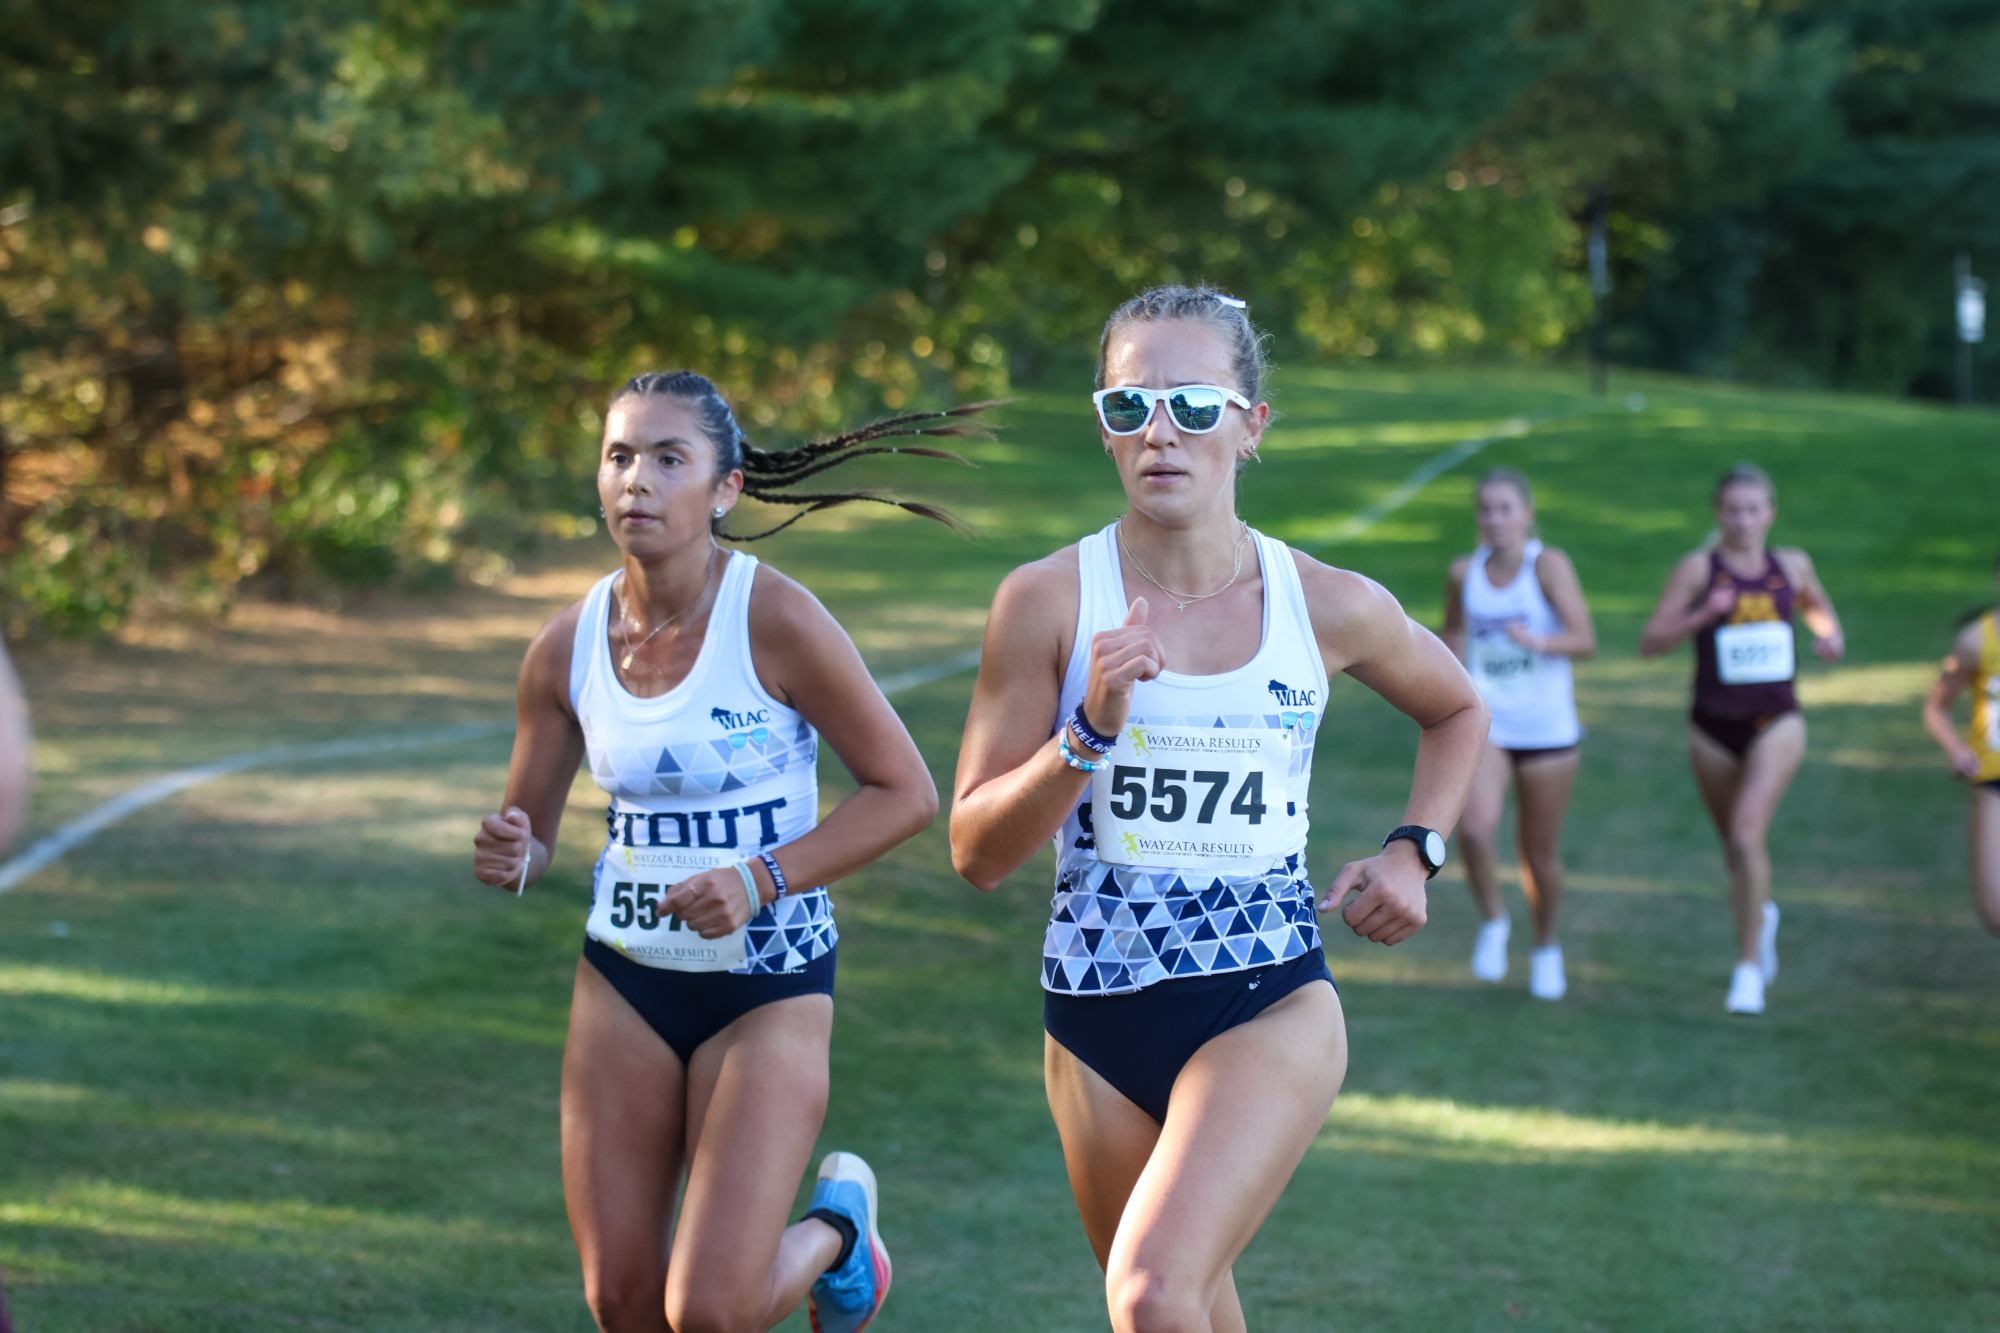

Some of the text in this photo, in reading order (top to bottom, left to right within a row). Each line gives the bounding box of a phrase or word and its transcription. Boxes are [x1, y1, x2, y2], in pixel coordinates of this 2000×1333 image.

[1269, 688, 1317, 707] WIAC
[713, 709, 770, 730] WIAC
[1146, 735, 1262, 749] WAYZATA RESULTS
[1110, 765, 1267, 825] 5574
[1139, 838, 1254, 854] WAYZATA RESULTS
[633, 853, 720, 865] WAYZATA RESULTS
[626, 945, 672, 957] WAYZATA
[674, 947, 718, 958] RESULTS
